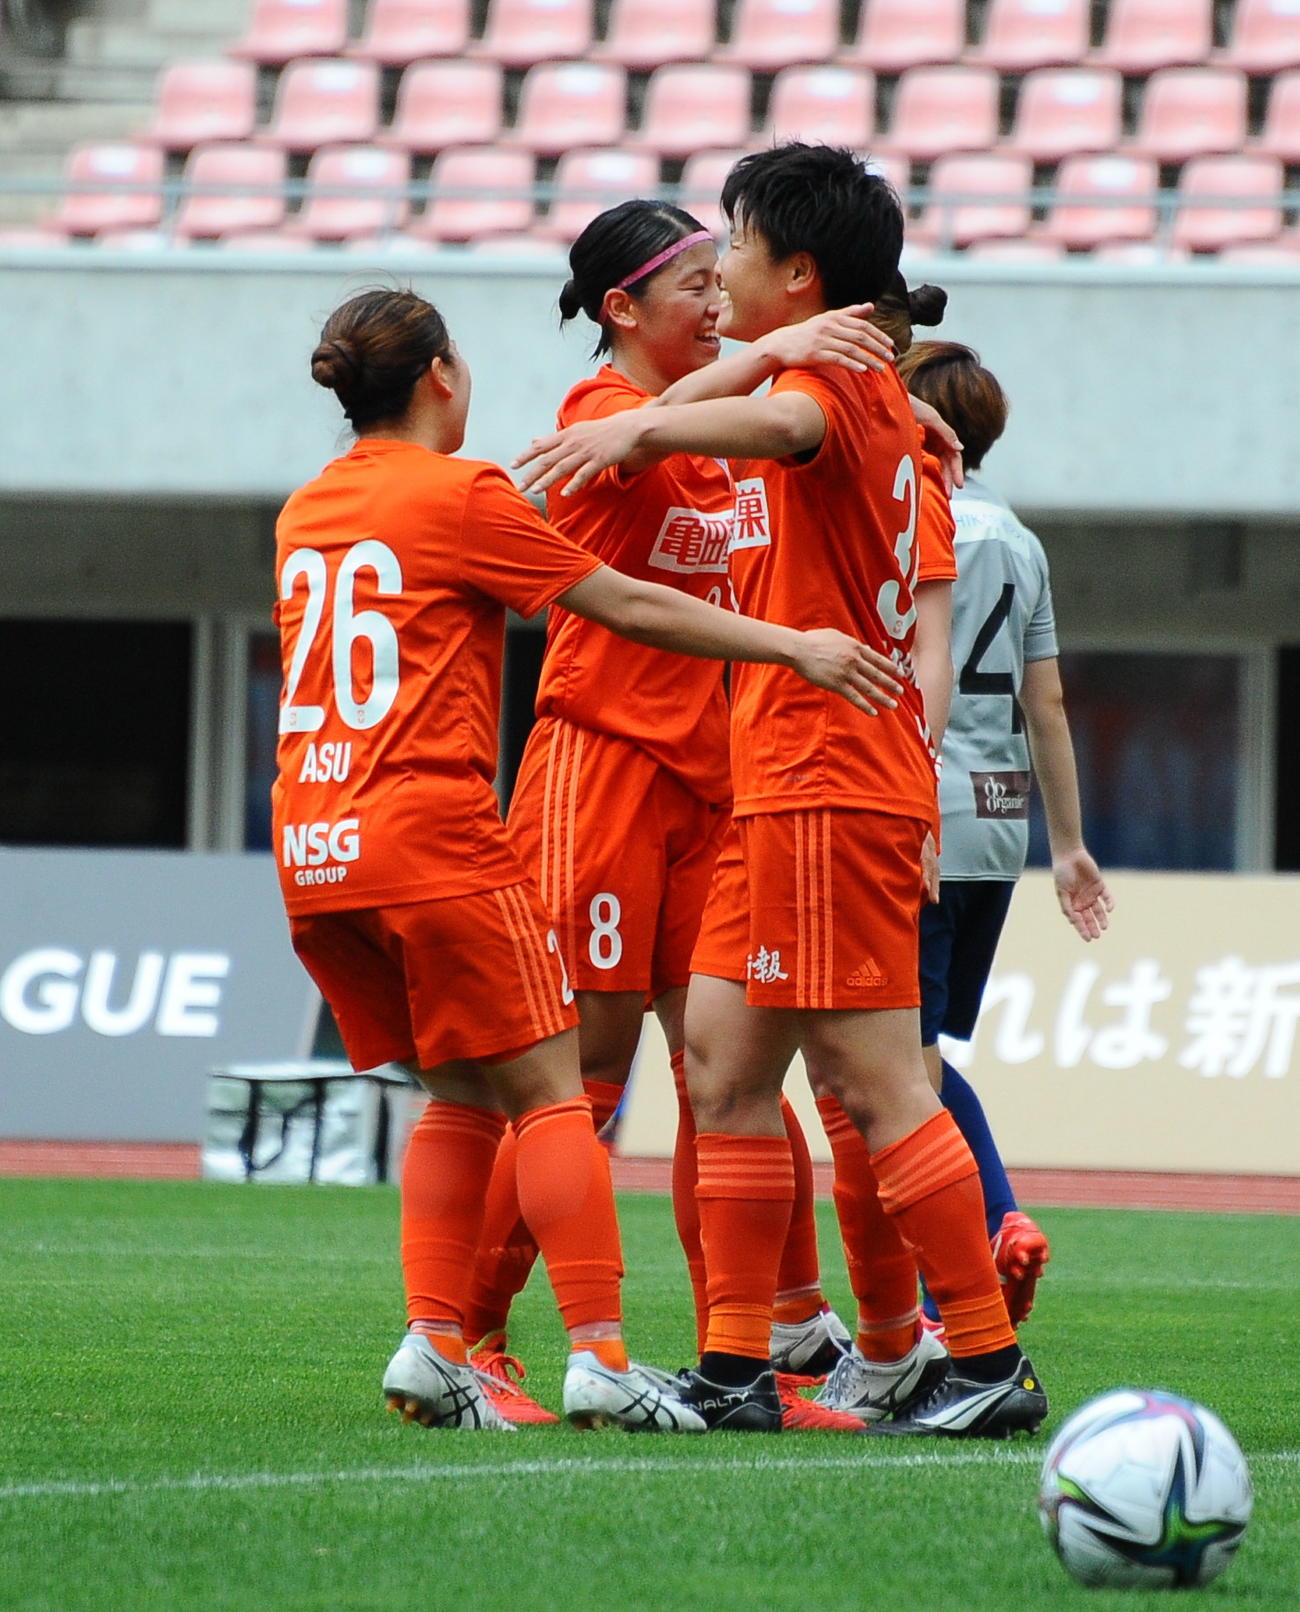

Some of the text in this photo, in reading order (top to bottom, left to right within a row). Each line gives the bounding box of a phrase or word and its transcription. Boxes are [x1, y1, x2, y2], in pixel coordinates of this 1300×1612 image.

[735, 487, 766, 540] 菓
[658, 516, 734, 567] 亀田
[279, 539, 402, 734] 26
[959, 583, 1022, 734] 4
[298, 742, 351, 783] ASU
[283, 818, 360, 867] NSG
[294, 866, 347, 886] GROUP
[589, 893, 623, 970] 8
[0, 949, 231, 1038] GUE
[847, 976, 889, 988] adidas
[682, 1391, 750, 1411] NALTY
